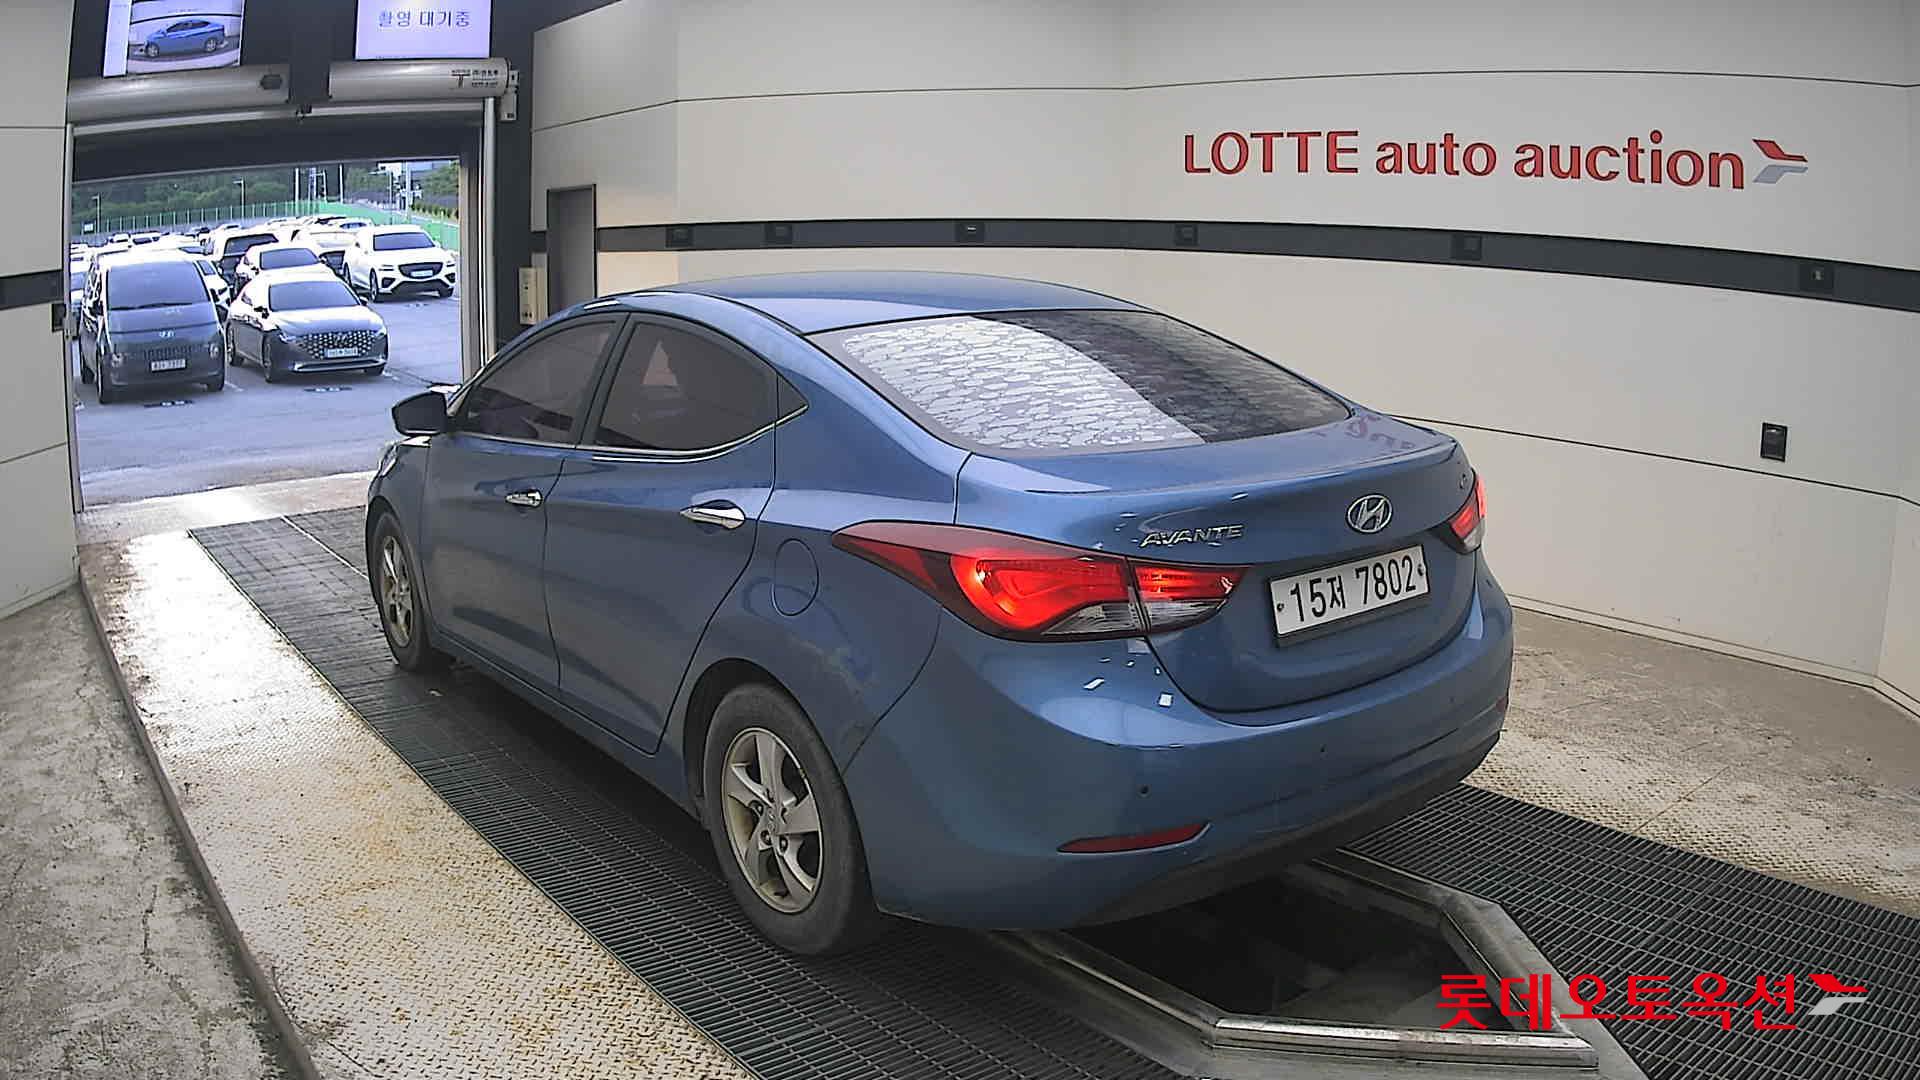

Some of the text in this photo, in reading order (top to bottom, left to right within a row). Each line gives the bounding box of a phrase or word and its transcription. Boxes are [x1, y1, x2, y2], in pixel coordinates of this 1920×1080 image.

[419, 10, 471, 27] 대기중
[1184, 130, 1745, 189] LOTTE auto auction
[1139, 525, 1244, 548] AVANTE
[1289, 555, 1417, 622] 15저 7802
